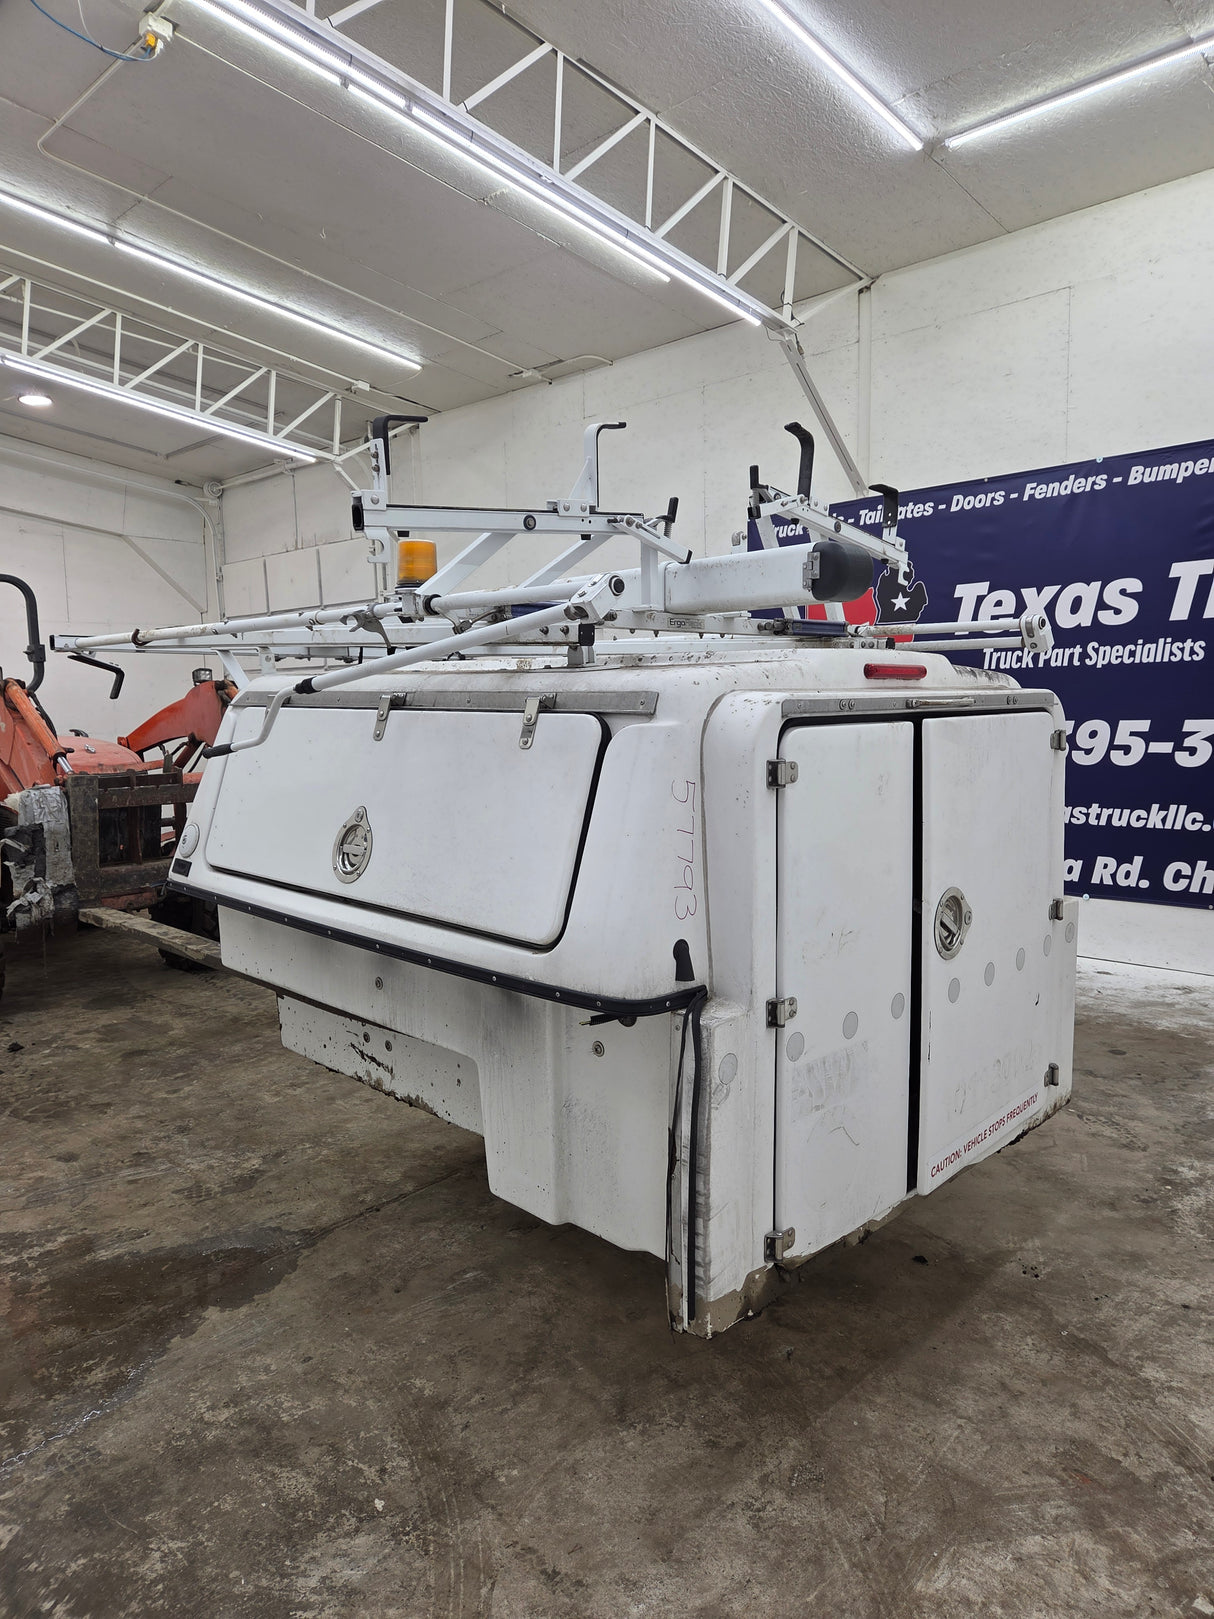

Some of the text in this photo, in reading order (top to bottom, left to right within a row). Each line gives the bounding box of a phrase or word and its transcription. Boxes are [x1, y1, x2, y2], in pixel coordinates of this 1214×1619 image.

[773, 523, 804, 538] ruck
[859, 501, 934, 526] Tailates
[949, 489, 1004, 514] Doors
[1022, 474, 1108, 502] Fenders
[953, 577, 1143, 636] Texas
[983, 637, 1206, 670] Truck Part Specialists
[671, 779, 697, 920] 57793
[1090, 855, 1150, 889] Rd.
[930, 1092, 1038, 1178] CAUTION: VEHICLE STOPS FREQUENTLY
